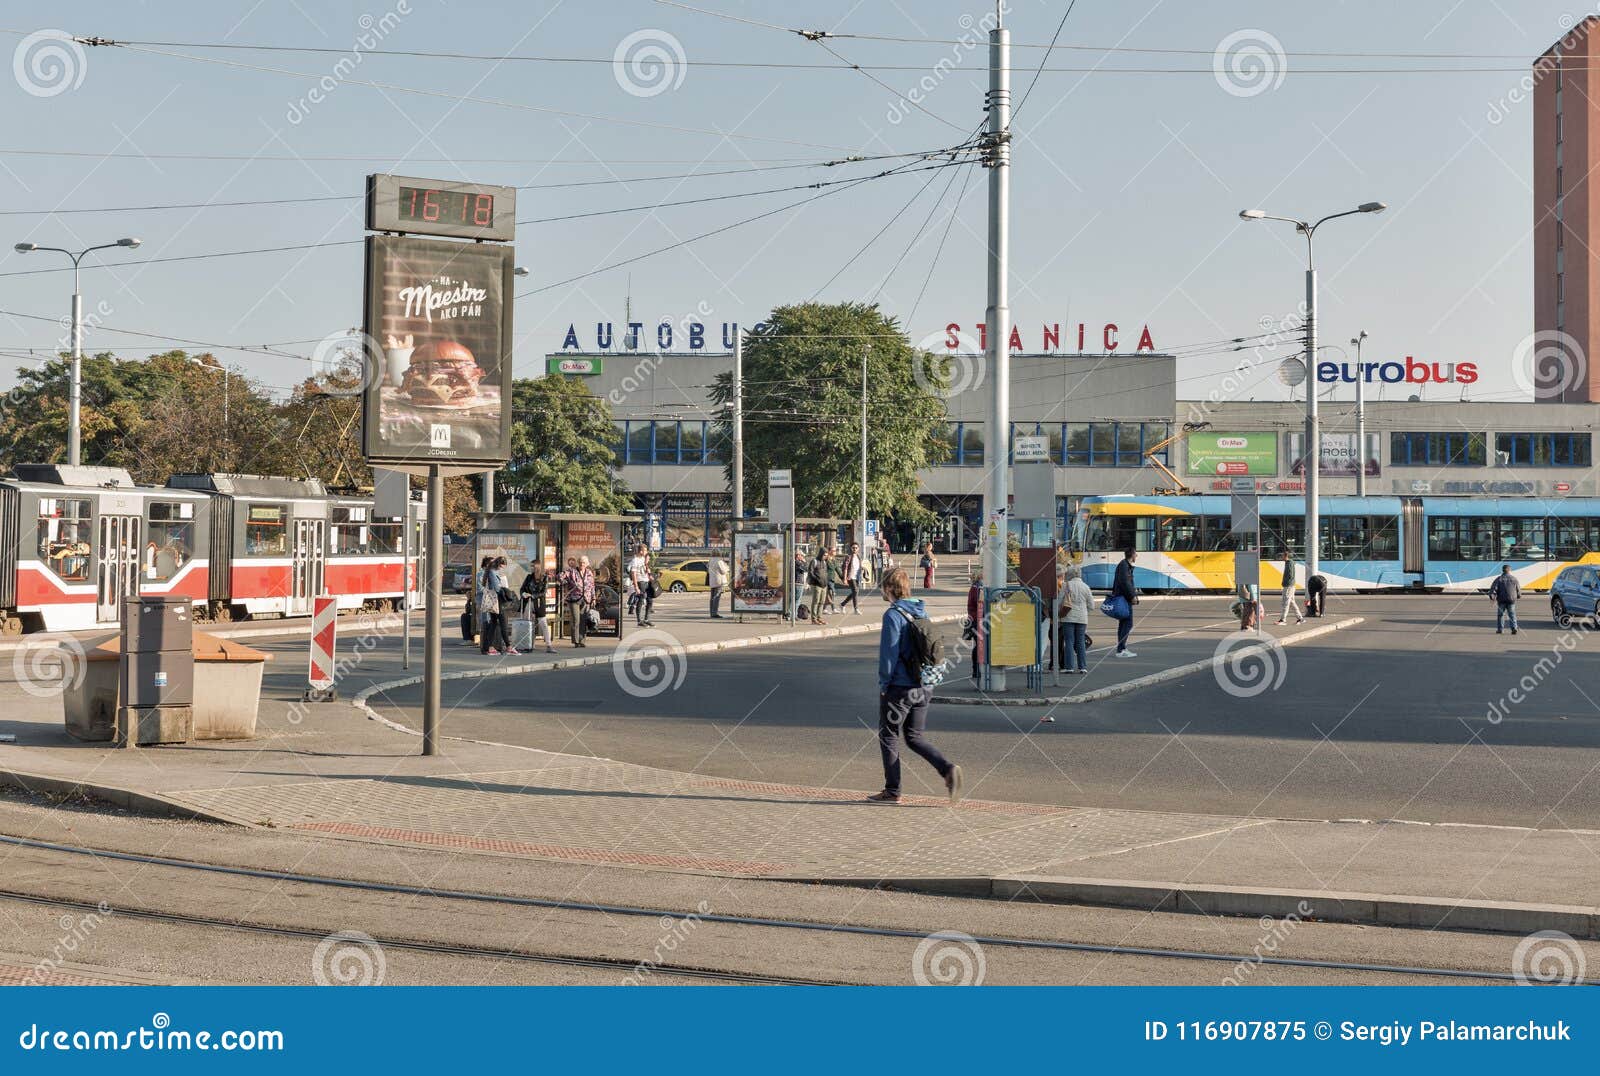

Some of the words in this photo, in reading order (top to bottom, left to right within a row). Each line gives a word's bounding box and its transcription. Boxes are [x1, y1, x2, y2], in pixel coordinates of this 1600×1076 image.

[409, 188, 493, 226] 16:18
[399, 281, 488, 323] Maestra
[944, 323, 1155, 351] STANICA
[1316, 356, 1479, 383] eurobus
